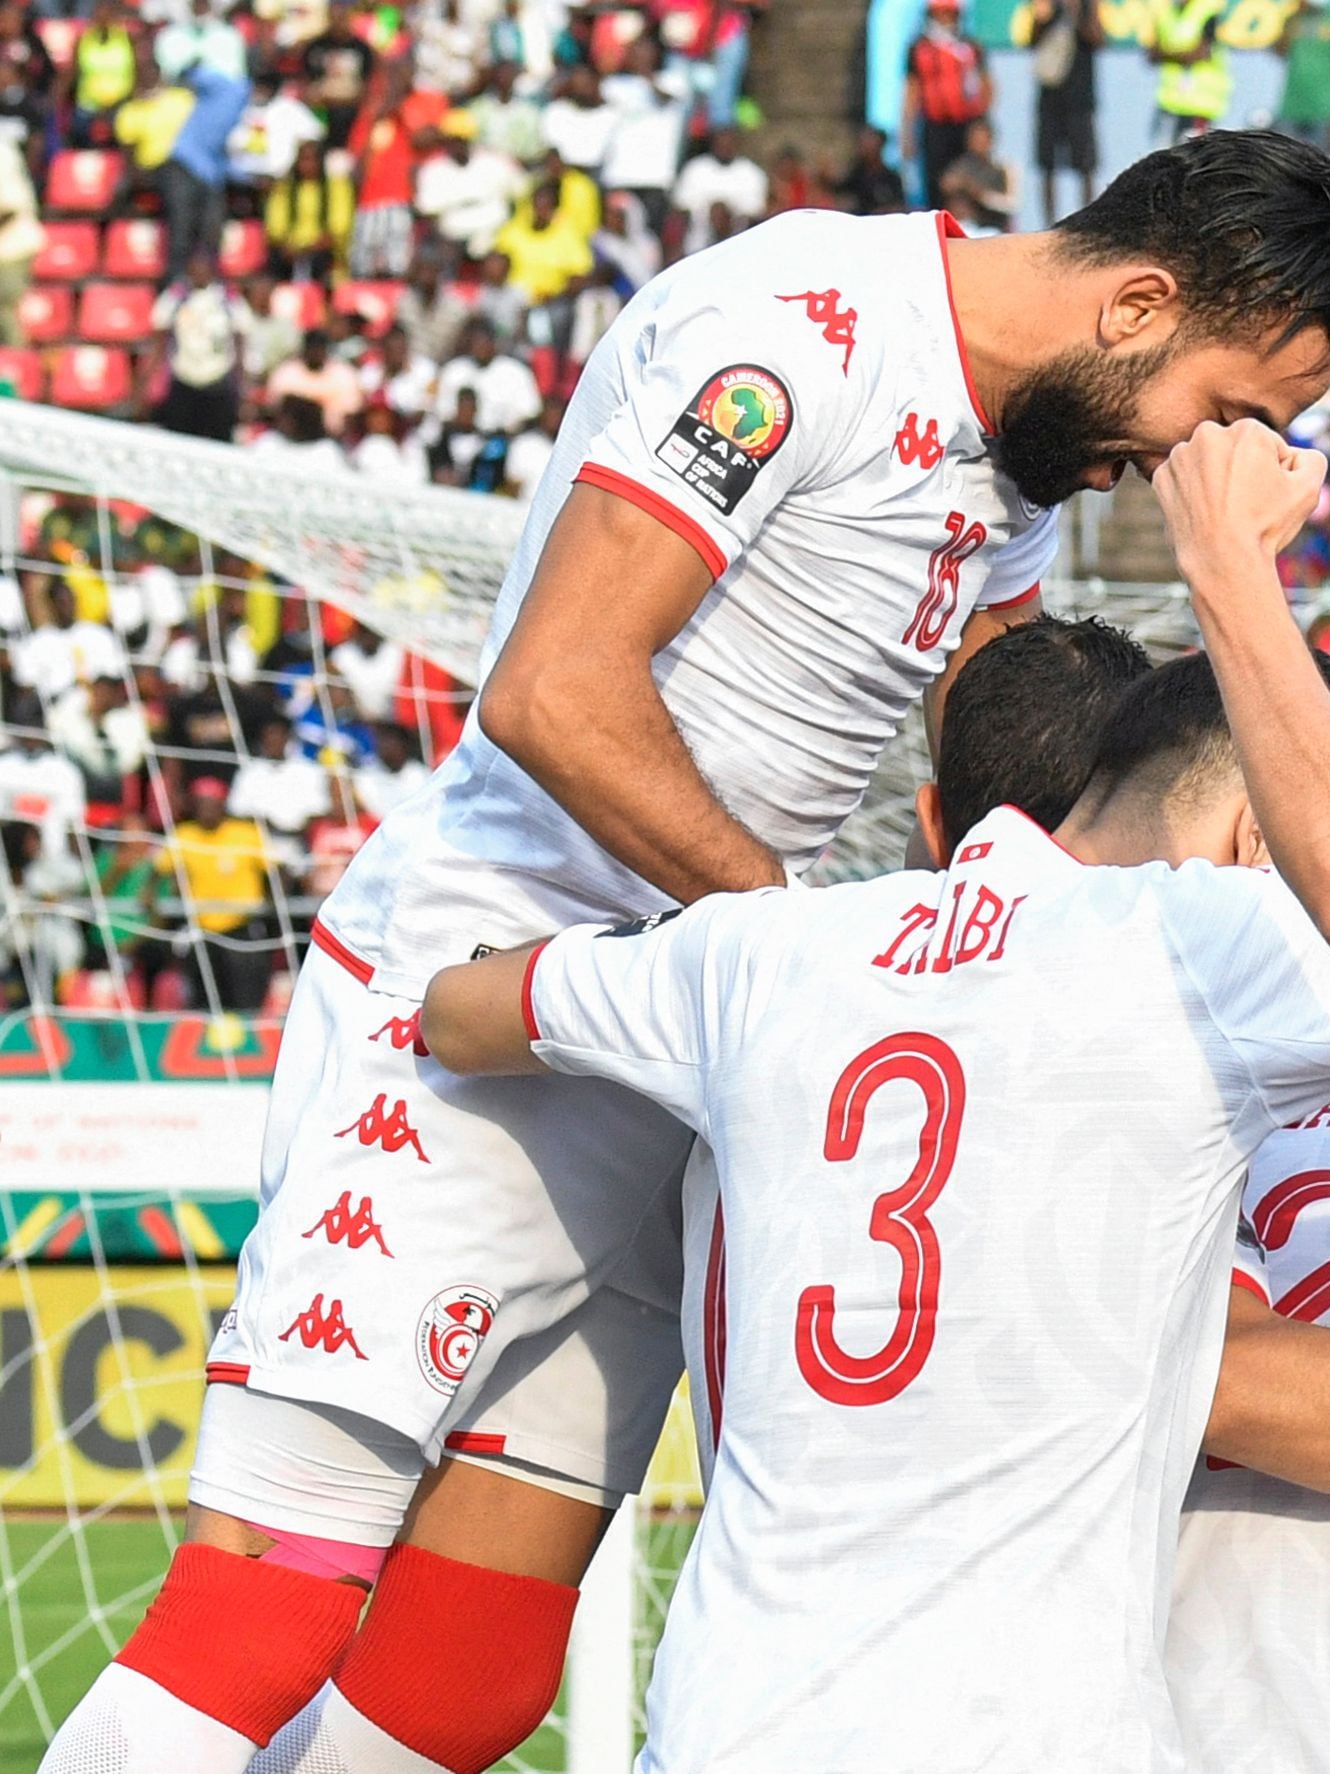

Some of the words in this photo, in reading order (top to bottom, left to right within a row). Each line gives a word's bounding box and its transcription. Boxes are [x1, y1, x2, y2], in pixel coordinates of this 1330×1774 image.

[694, 426, 748, 466] CAF
[691, 463, 710, 477] CUP
[698, 454, 728, 479] AFRICA
[685, 471, 698, 482] OF
[696, 479, 729, 508] NATIONS
[900, 511, 987, 652] 18
[795, 1032, 966, 1406] 3
